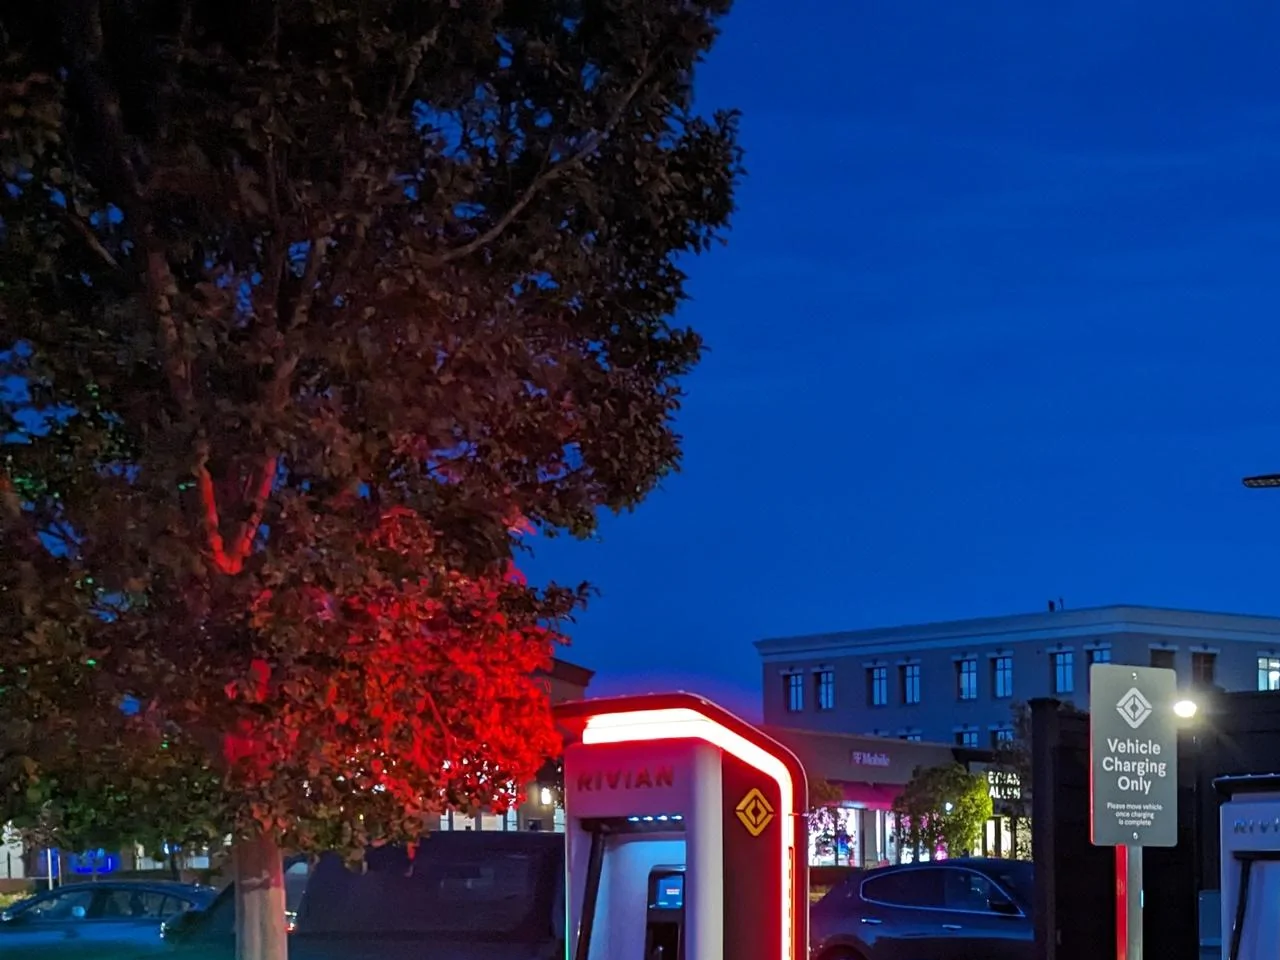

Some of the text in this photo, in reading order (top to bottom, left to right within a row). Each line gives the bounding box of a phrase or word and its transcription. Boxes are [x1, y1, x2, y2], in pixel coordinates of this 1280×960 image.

[1107, 738, 1161, 755] Vehicle
[1102, 756, 1167, 777] Charging
[577, 766, 674, 792] RIVIAN
[1117, 776, 1152, 795] Only
[1107, 802, 1163, 811] Please move vehicle
[1124, 819, 1152, 827] complete
[1131, 811, 1154, 820] charging
